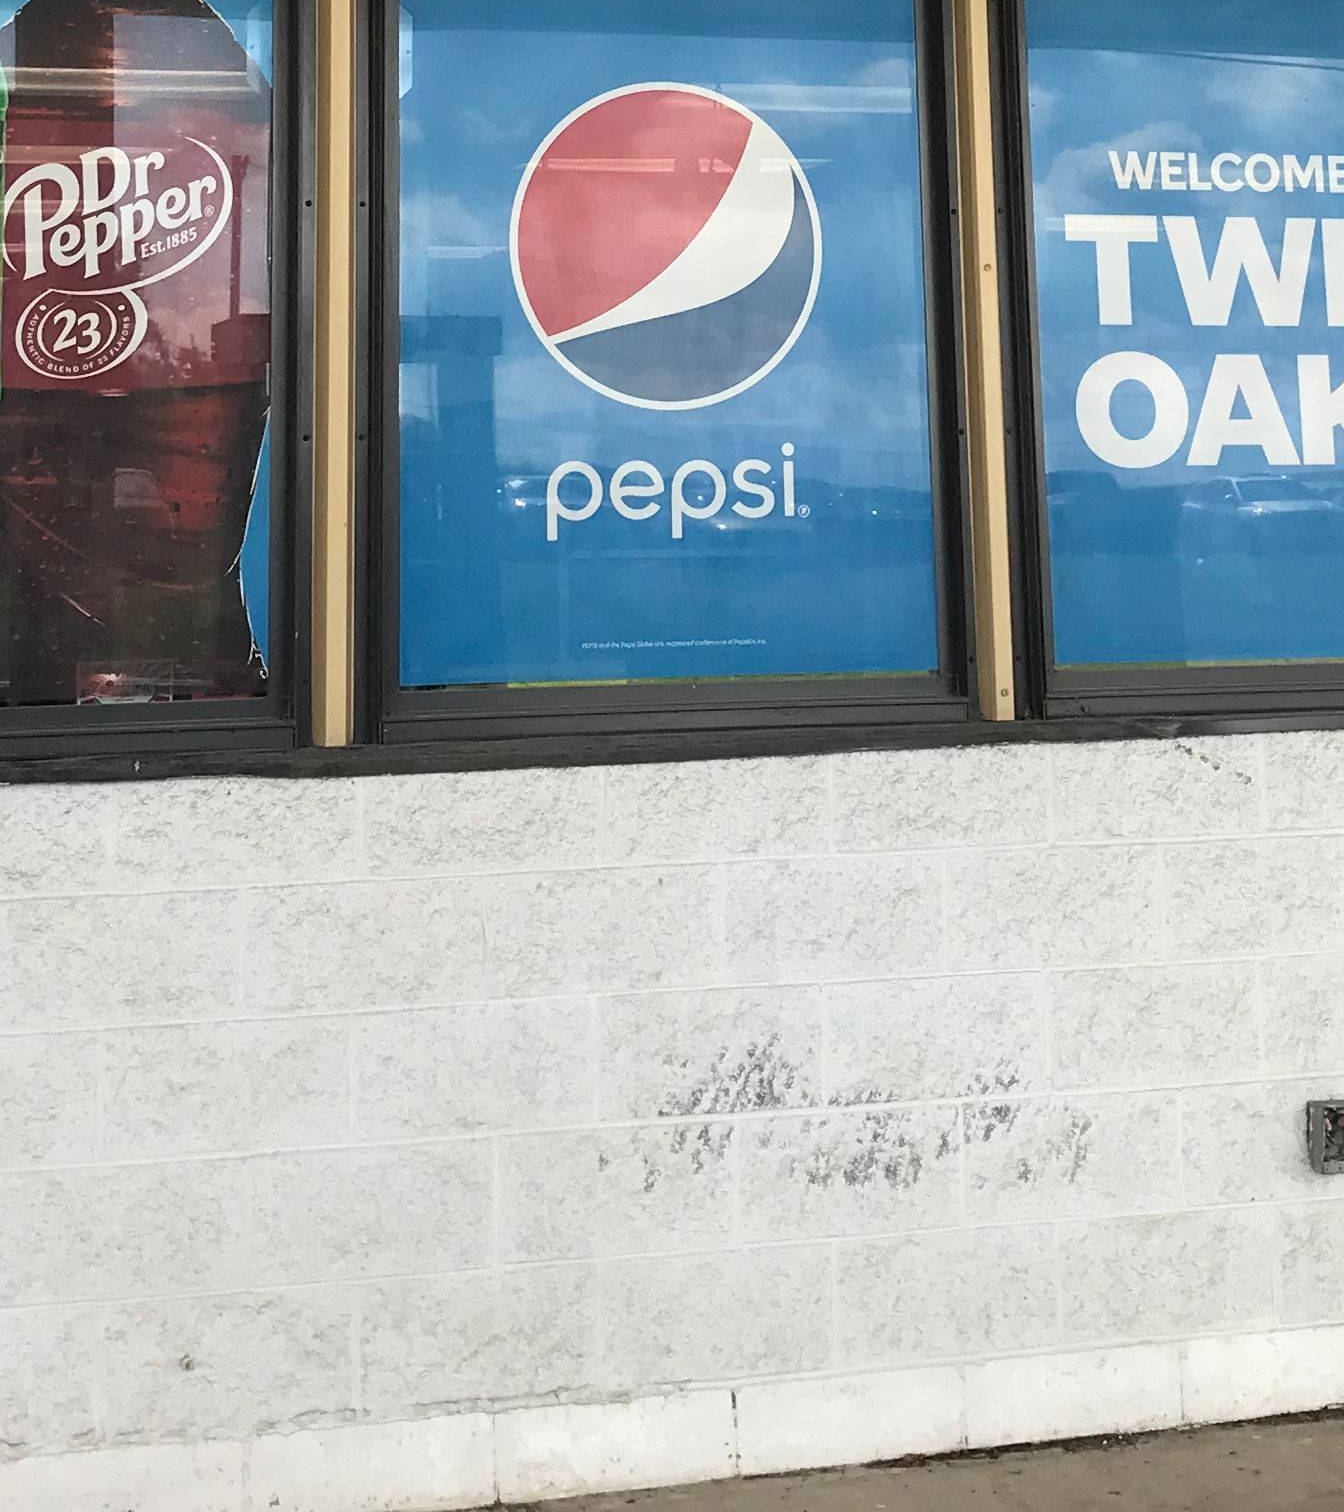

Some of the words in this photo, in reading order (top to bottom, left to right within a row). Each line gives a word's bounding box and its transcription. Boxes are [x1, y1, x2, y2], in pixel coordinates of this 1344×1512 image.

[80, 147, 165, 216] Dr
[4, 163, 217, 281] Pepper
[26, 313, 46, 366] AUTHENTIC
[47, 362, 80, 373] BLEND
[82, 361, 94, 371] OF
[109, 316, 131, 356] FLAVORS
[53, 309, 102, 355] 23
[546, 442, 796, 541] pepsi
